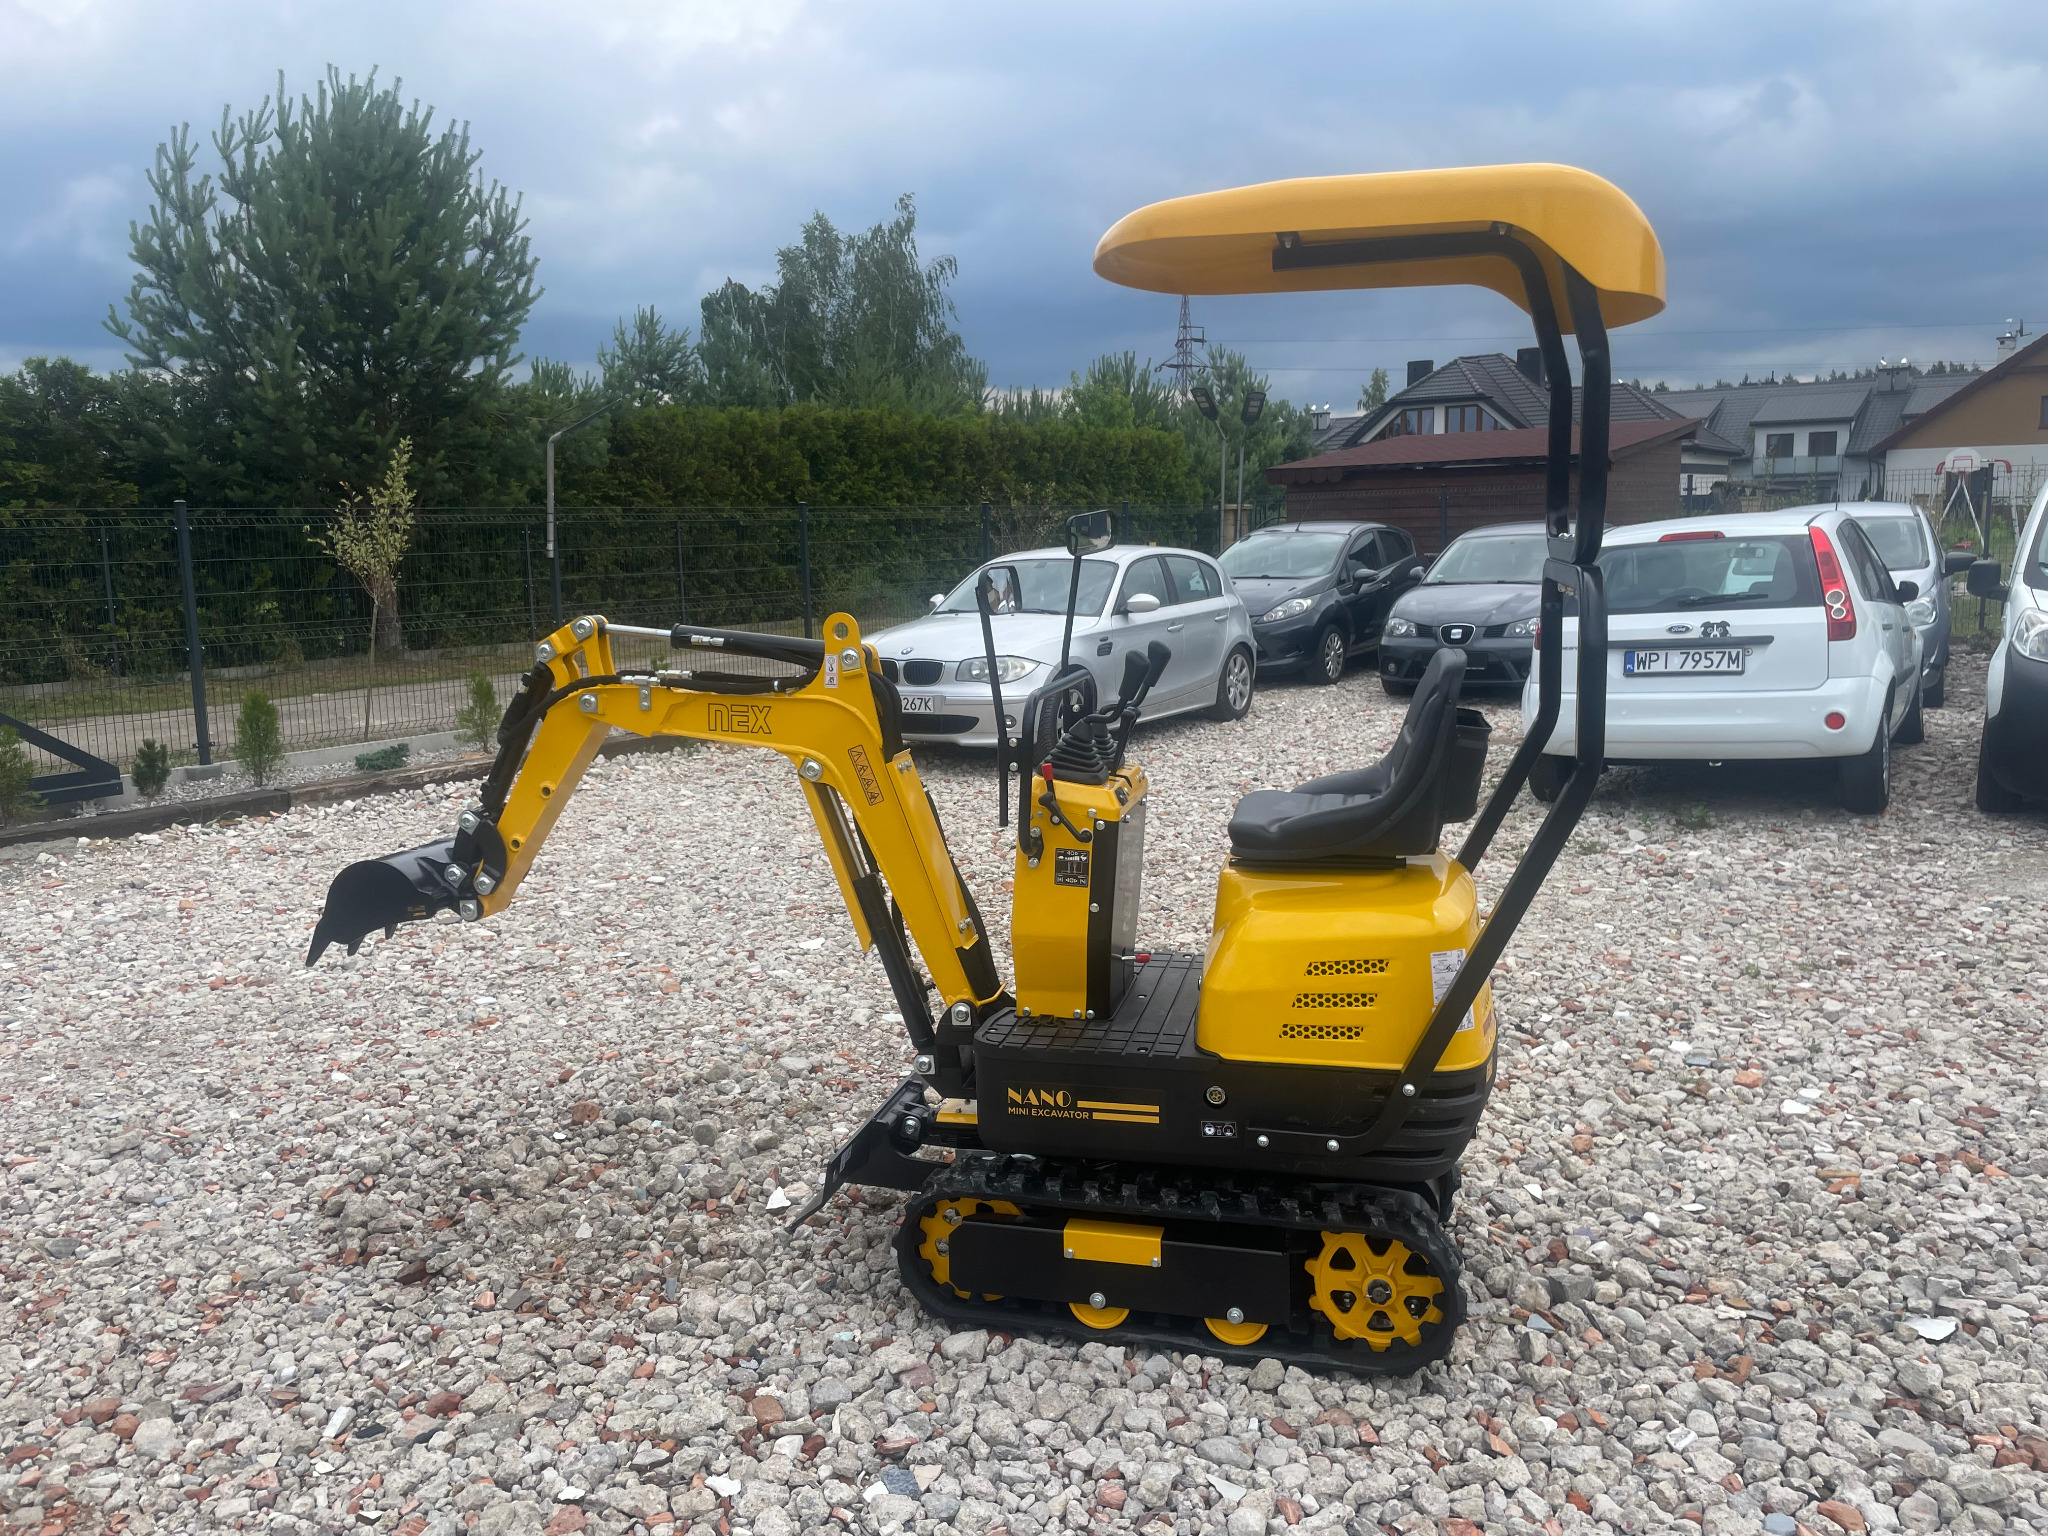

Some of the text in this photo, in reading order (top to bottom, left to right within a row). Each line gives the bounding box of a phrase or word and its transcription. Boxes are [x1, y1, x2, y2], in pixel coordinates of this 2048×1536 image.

[1636, 650, 1741, 671] WPI 7957M
[708, 703, 772, 734] NEX
[1008, 1087, 1072, 1108] NANO
[1008, 1106, 1089, 1120] MINI EXCAVATOR
